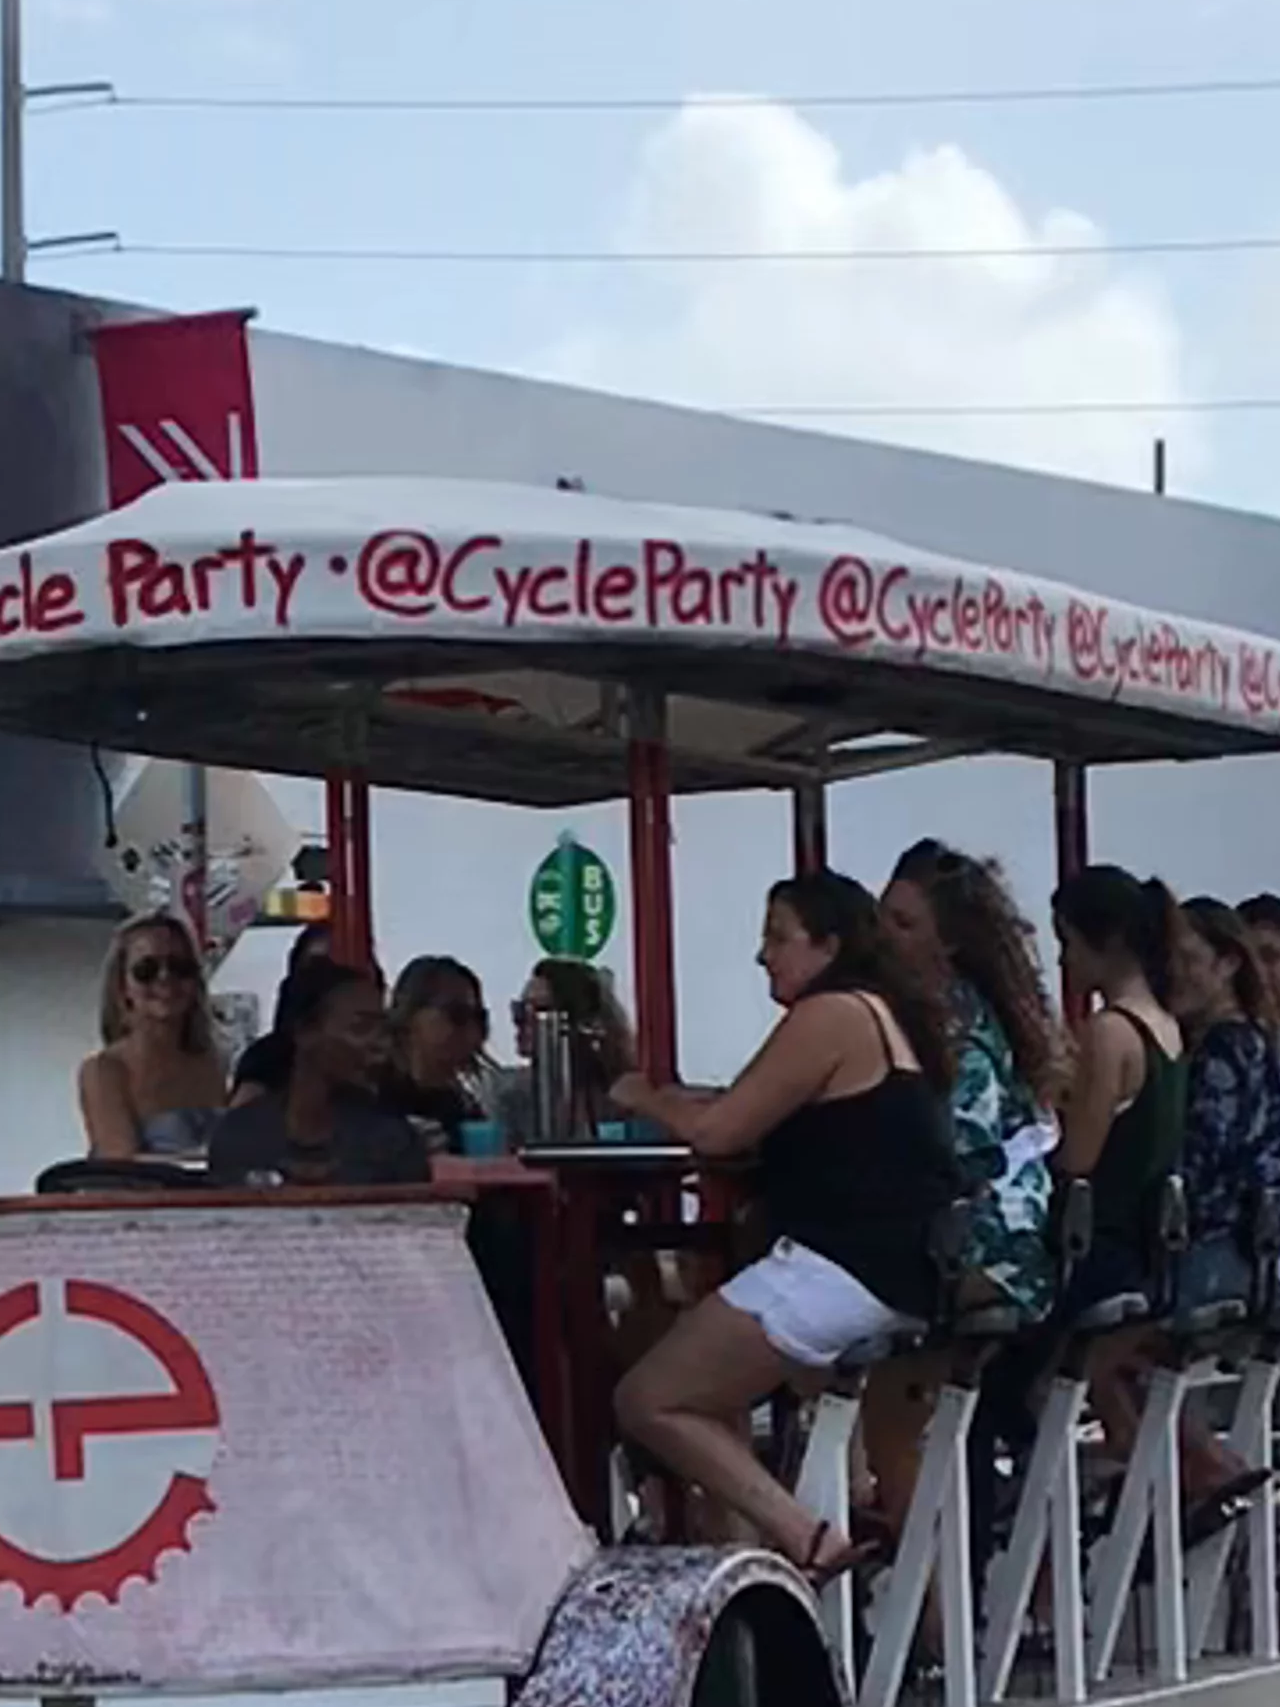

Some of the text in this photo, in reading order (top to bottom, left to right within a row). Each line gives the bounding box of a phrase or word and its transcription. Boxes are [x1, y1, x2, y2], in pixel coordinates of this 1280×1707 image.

[108, 529, 305, 626] Party
[357, 530, 797, 652] @CycleParty
[821, 555, 1056, 677] @CycleParty
[1068, 598, 1230, 711] @CycleParty
[582, 864, 604, 946] BUS
